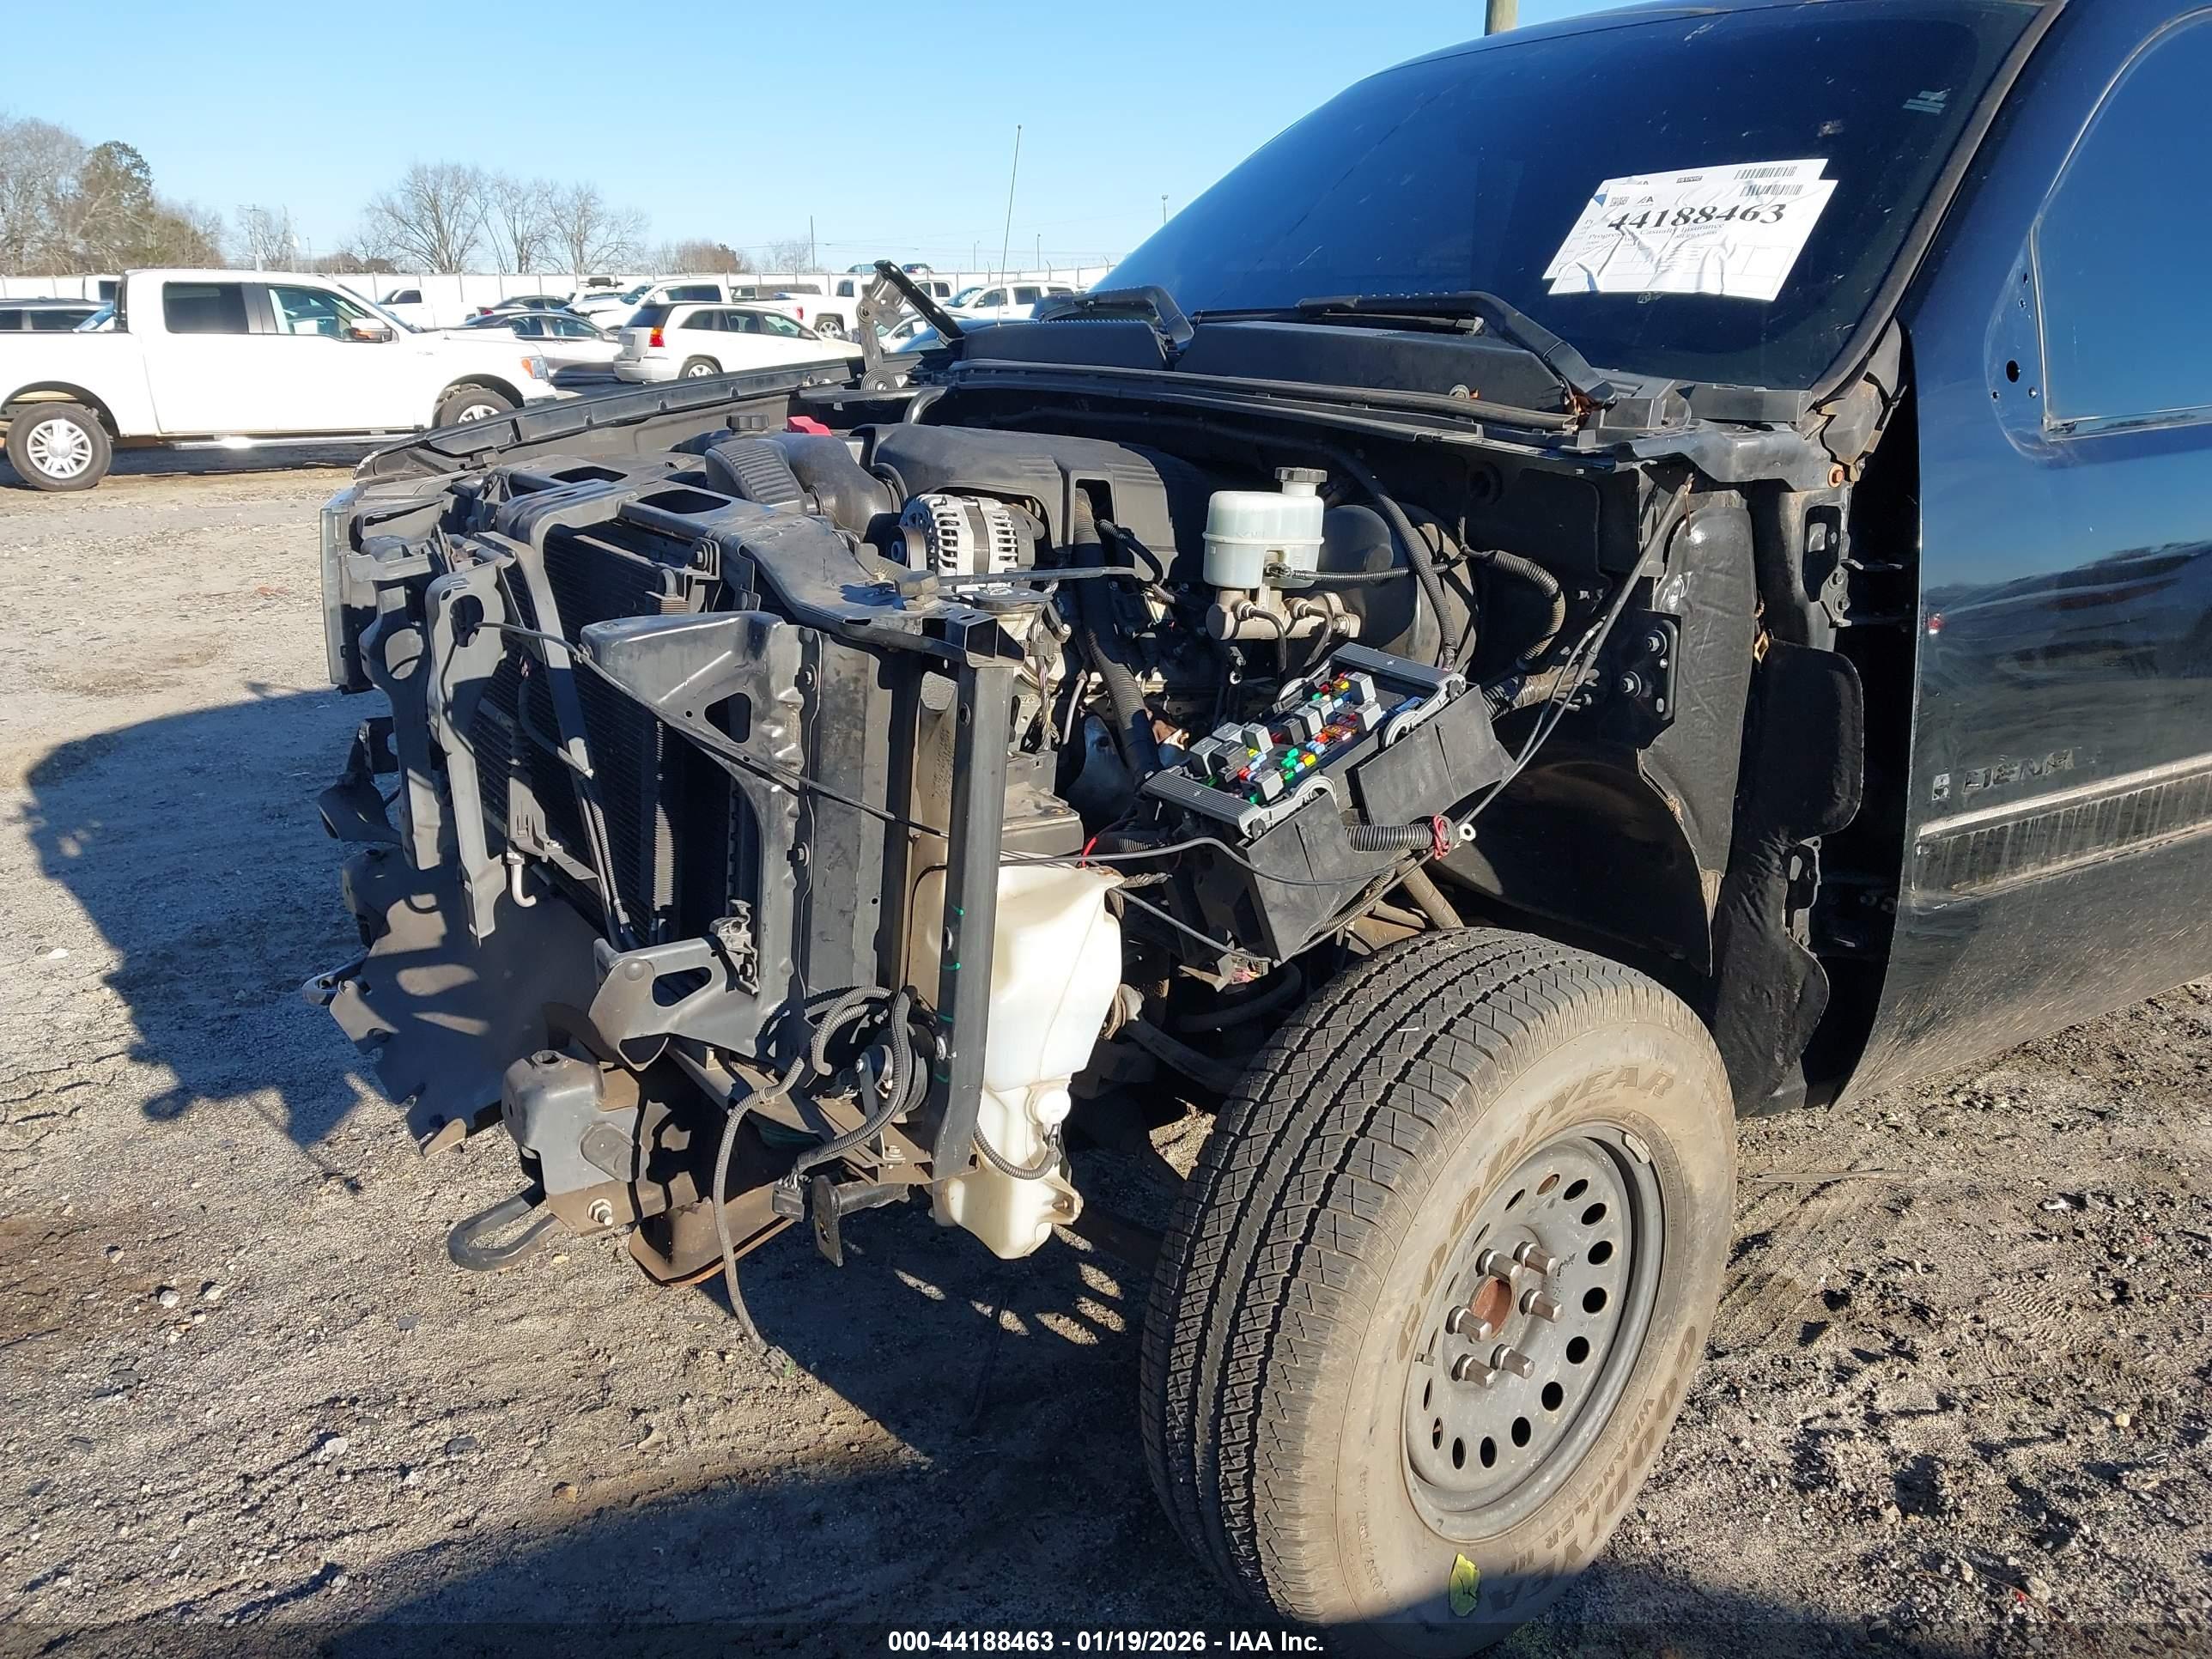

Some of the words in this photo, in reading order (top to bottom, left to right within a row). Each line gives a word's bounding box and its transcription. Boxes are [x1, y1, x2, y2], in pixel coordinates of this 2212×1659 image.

[1607, 204, 1787, 230] 44188463
[1396, 1065, 1674, 1363] GOODYEAR
[1487, 1325, 1697, 1612] GOODYEA
[1545, 1398, 1656, 1551] WRANGLER
